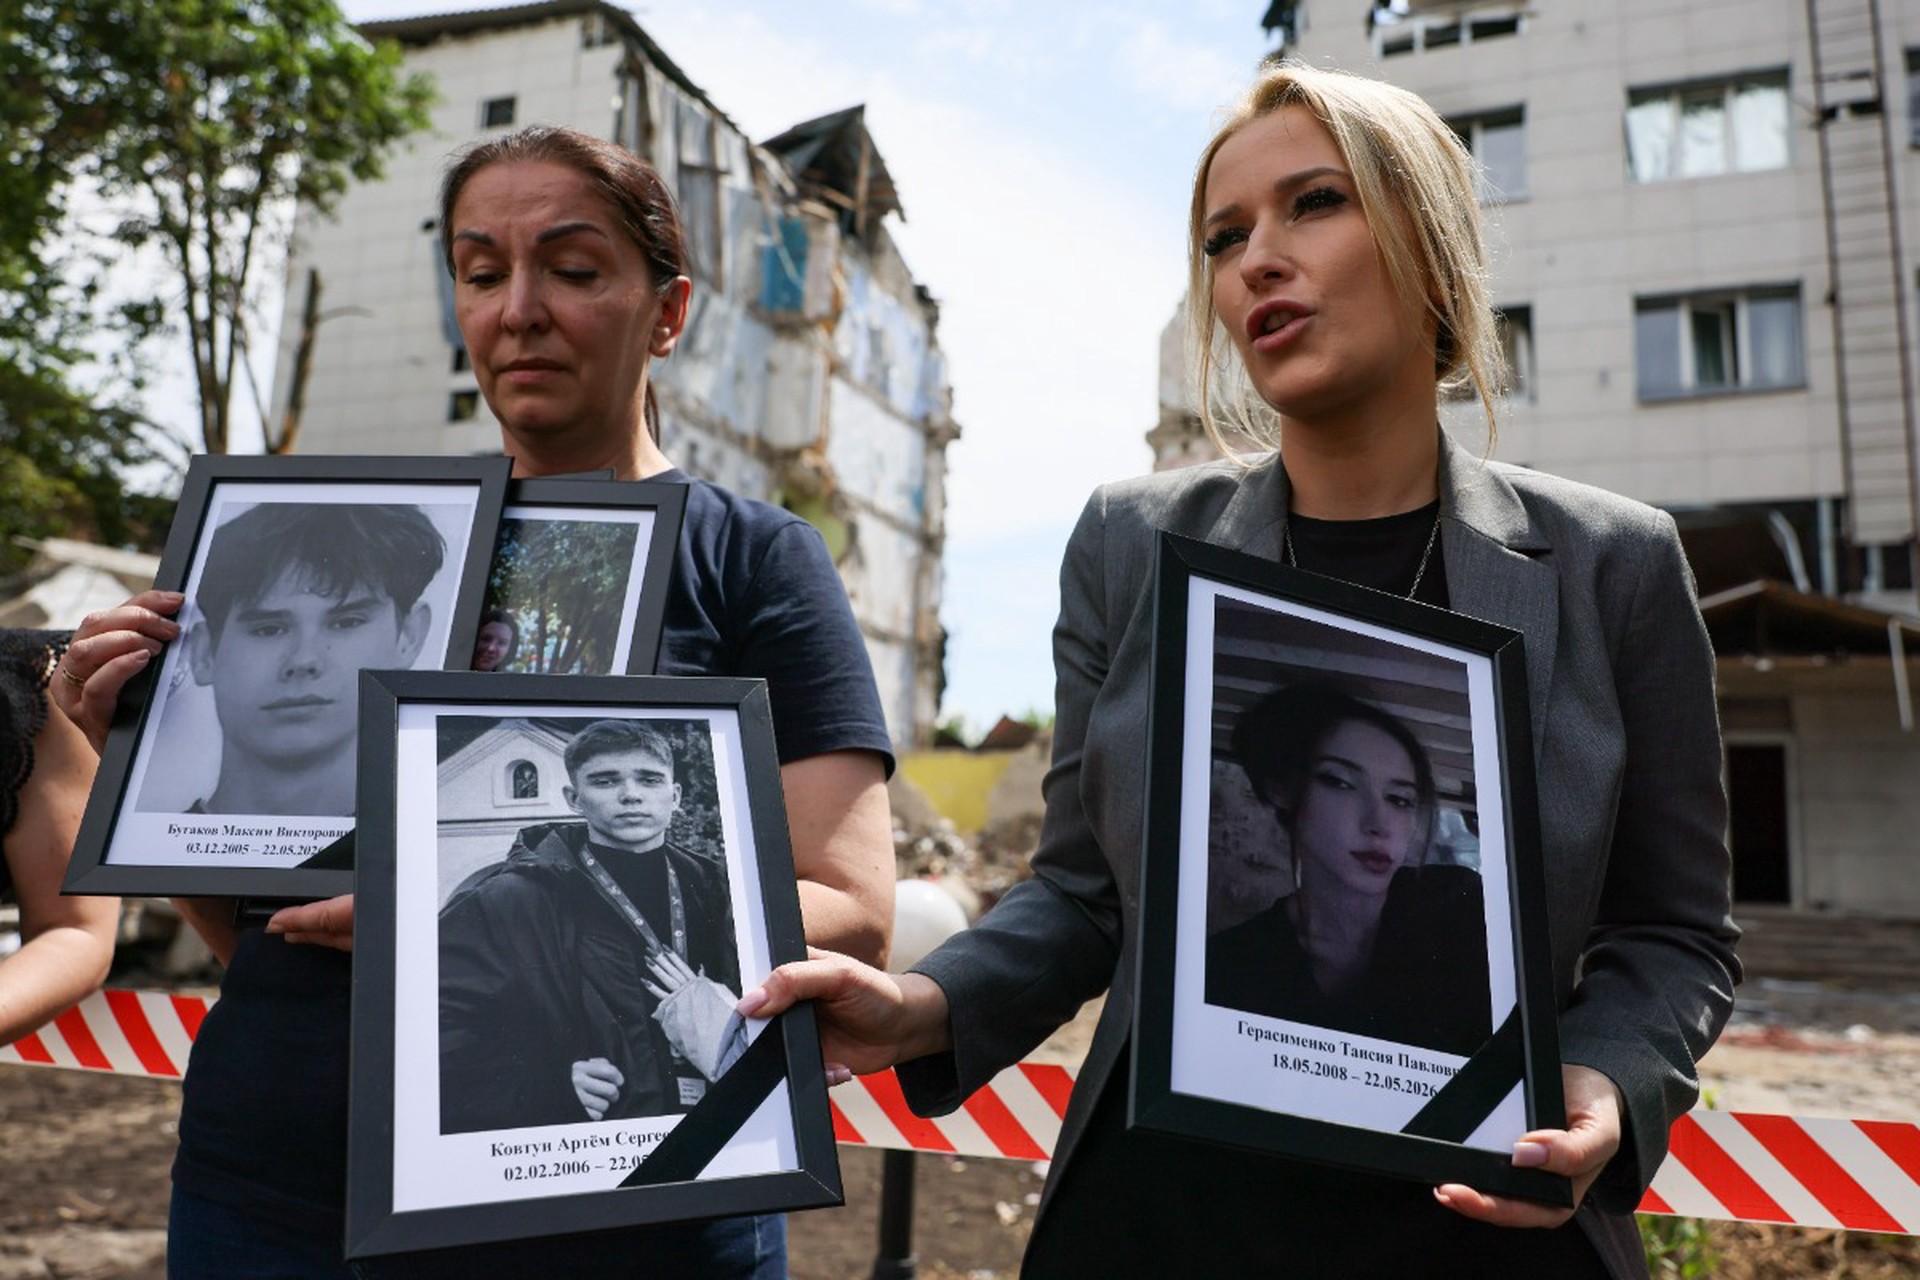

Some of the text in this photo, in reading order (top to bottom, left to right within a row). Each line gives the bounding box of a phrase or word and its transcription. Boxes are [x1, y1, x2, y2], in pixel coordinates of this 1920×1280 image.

[186, 842, 250, 855] 03.12.2005
[1237, 1020, 1337, 1054] Герасименко
[1340, 1040, 1394, 1065] Таисия
[1272, 1053, 1348, 1081] 18.05.2008
[491, 1142, 553, 1158] Ковтун
[557, 1135, 611, 1154] Артём
[503, 1160, 590, 1182] 02.02.2006
